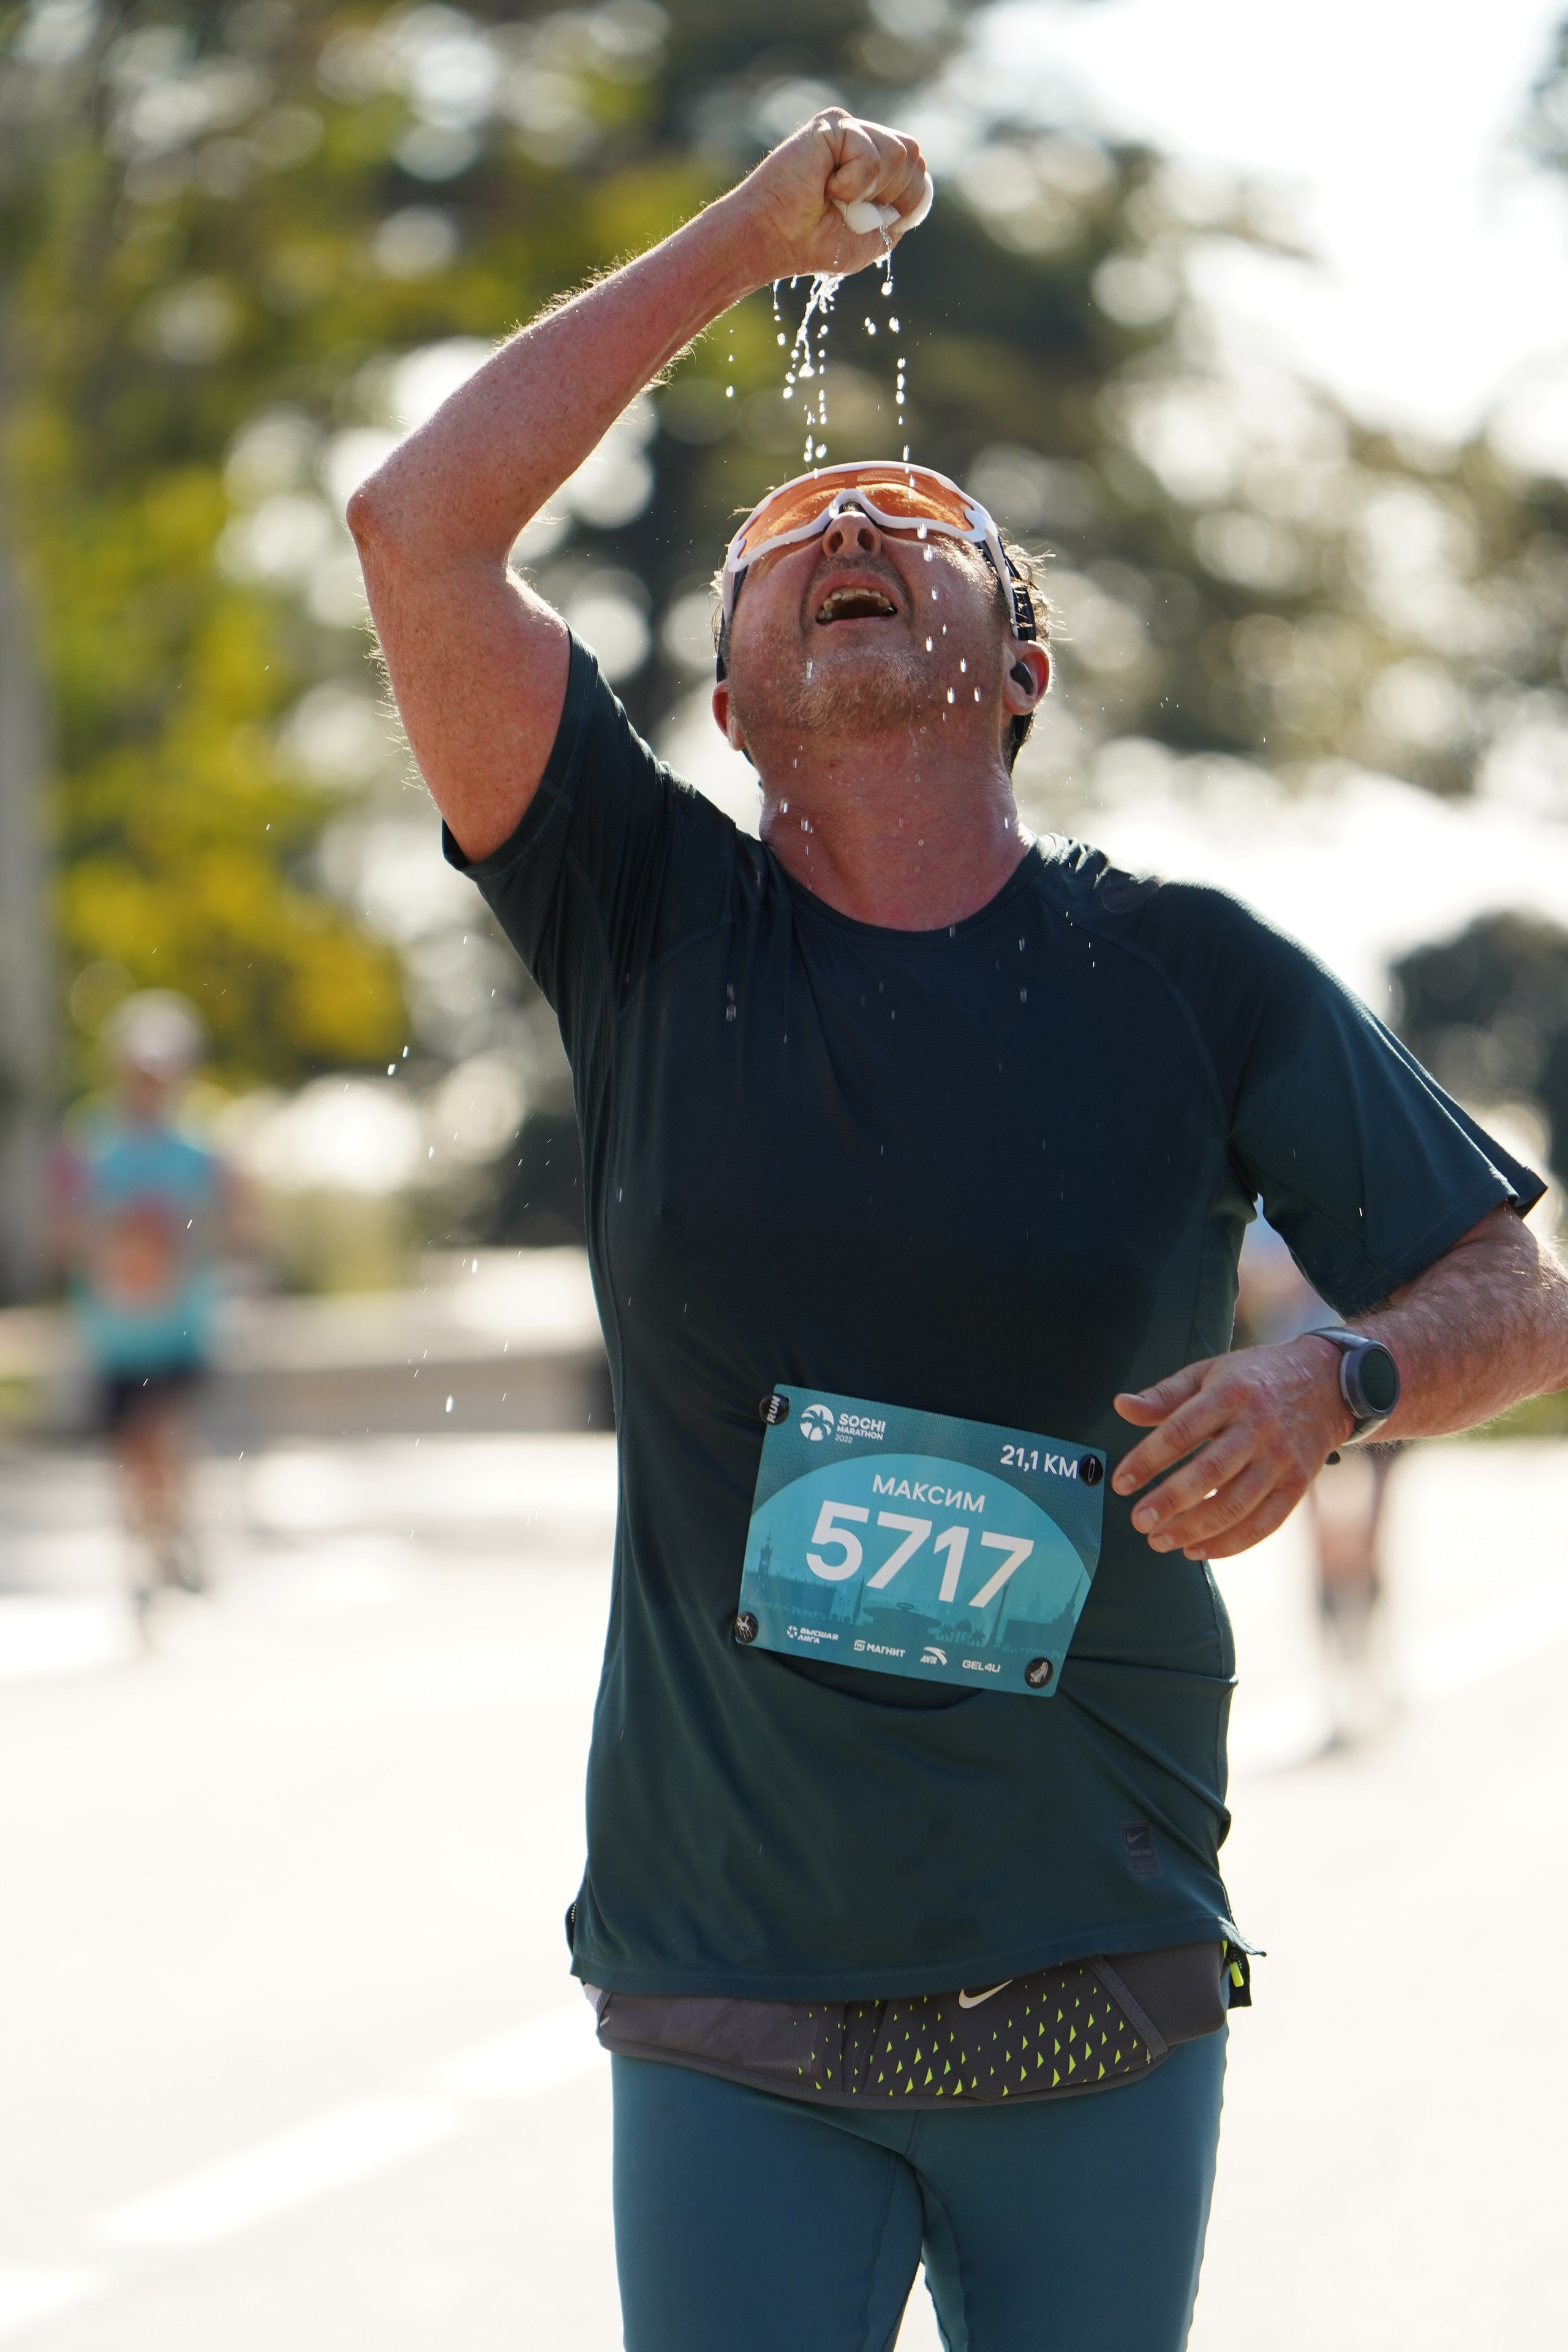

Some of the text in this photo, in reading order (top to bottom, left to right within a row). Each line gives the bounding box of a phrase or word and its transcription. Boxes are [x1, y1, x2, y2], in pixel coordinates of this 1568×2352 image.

[766, 1395, 781, 1424] RUN
[839, 1413, 886, 1433] SOCHI
[834, 1433, 853, 1444] 2022
[837, 1425, 883, 1441] MARATHON
[1000, 1444, 1038, 1472] 21,1
[872, 1474, 986, 1513] МАКСИМ
[806, 1500, 1035, 1608] 5717
[797, 1634, 820, 1645] ЛИГА
[799, 1627, 839, 1641] ВЫСШАЯ
[866, 1643, 906, 1658] МАГНИТ
[962, 1659, 1001, 1673] GEL4U
